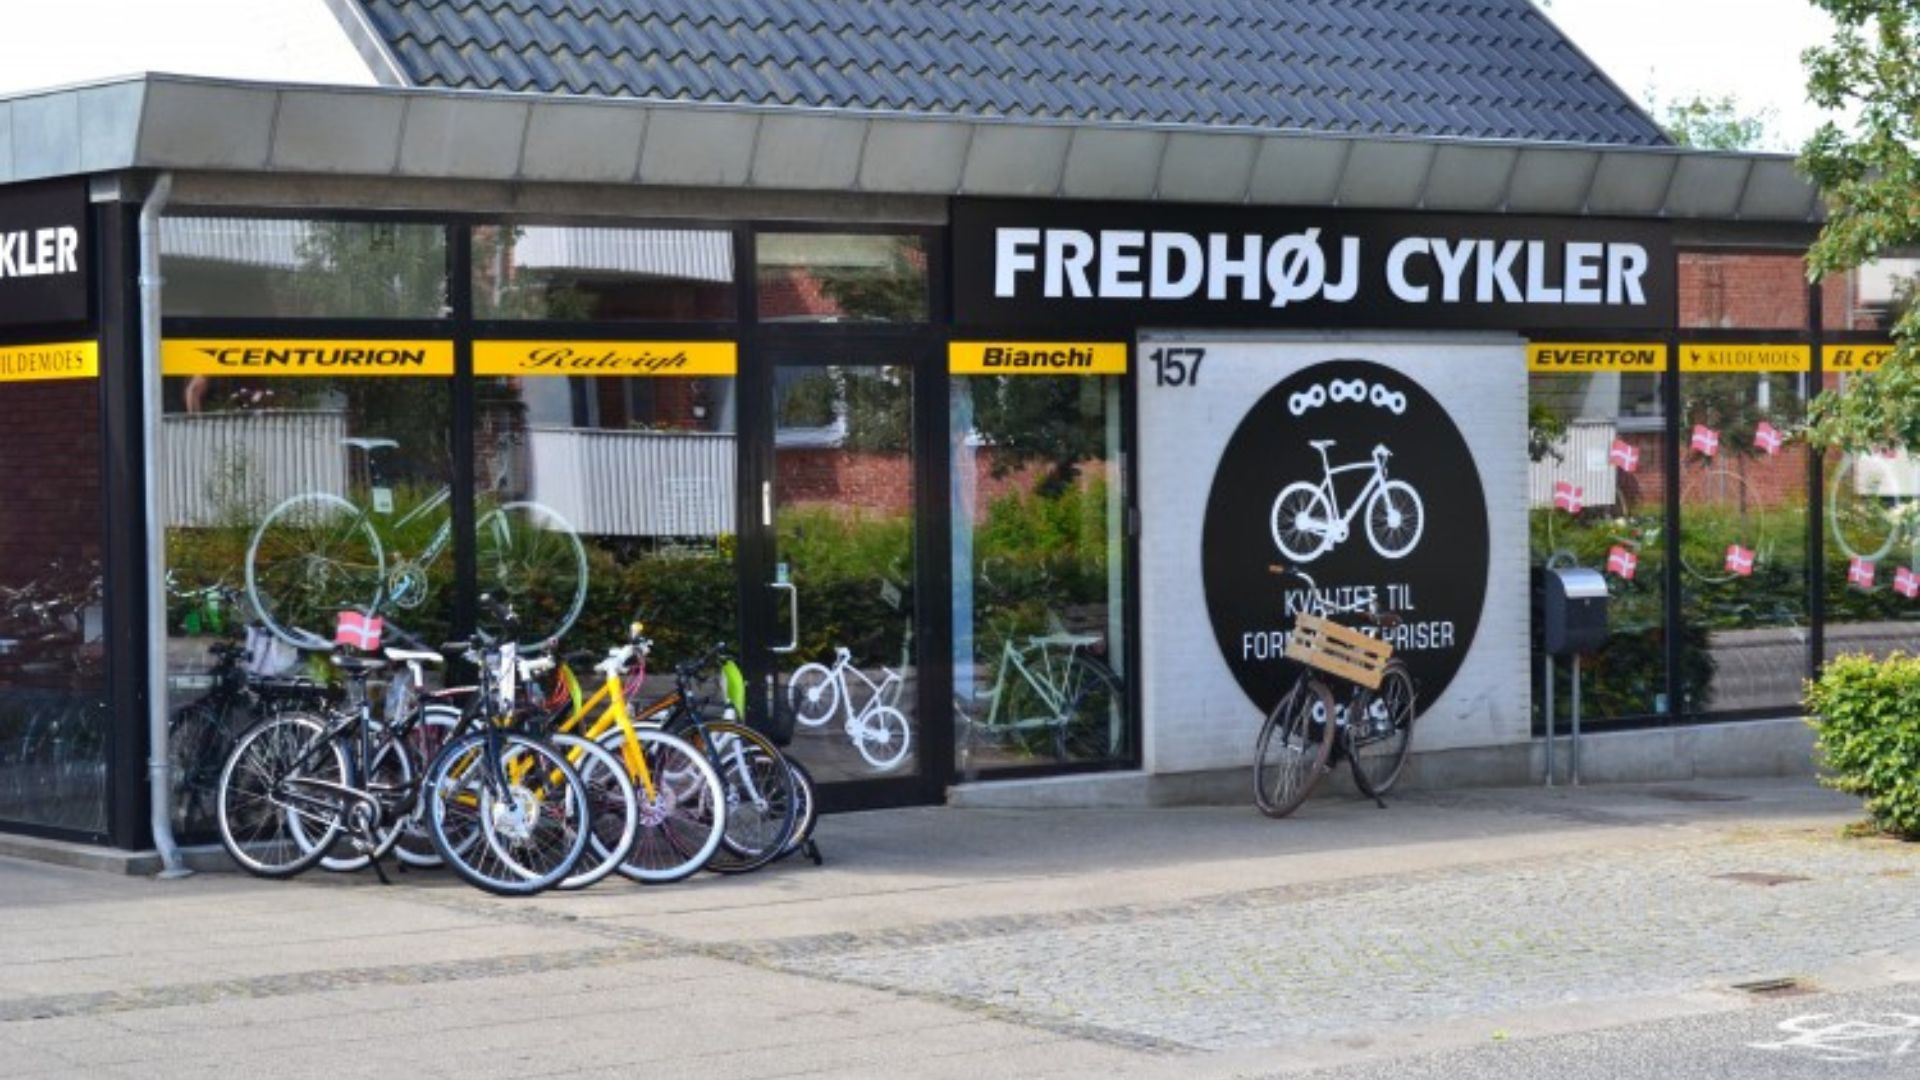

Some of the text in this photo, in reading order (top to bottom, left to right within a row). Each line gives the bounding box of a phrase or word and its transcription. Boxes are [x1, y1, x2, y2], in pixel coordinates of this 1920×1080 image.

[995, 227, 1647, 308] FREDHØJ CYKLER
[216, 348, 425, 367] CENTURION
[519, 347, 688, 372] Raleigh
[983, 347, 1094, 368] Bianchi
[1149, 347, 1206, 387] 157
[1535, 349, 1656, 366] EVERTON
[1707, 350, 1801, 366] KILDEMOES
[1833, 350, 1853, 366] EL
[1386, 584, 1415, 611] TIL
